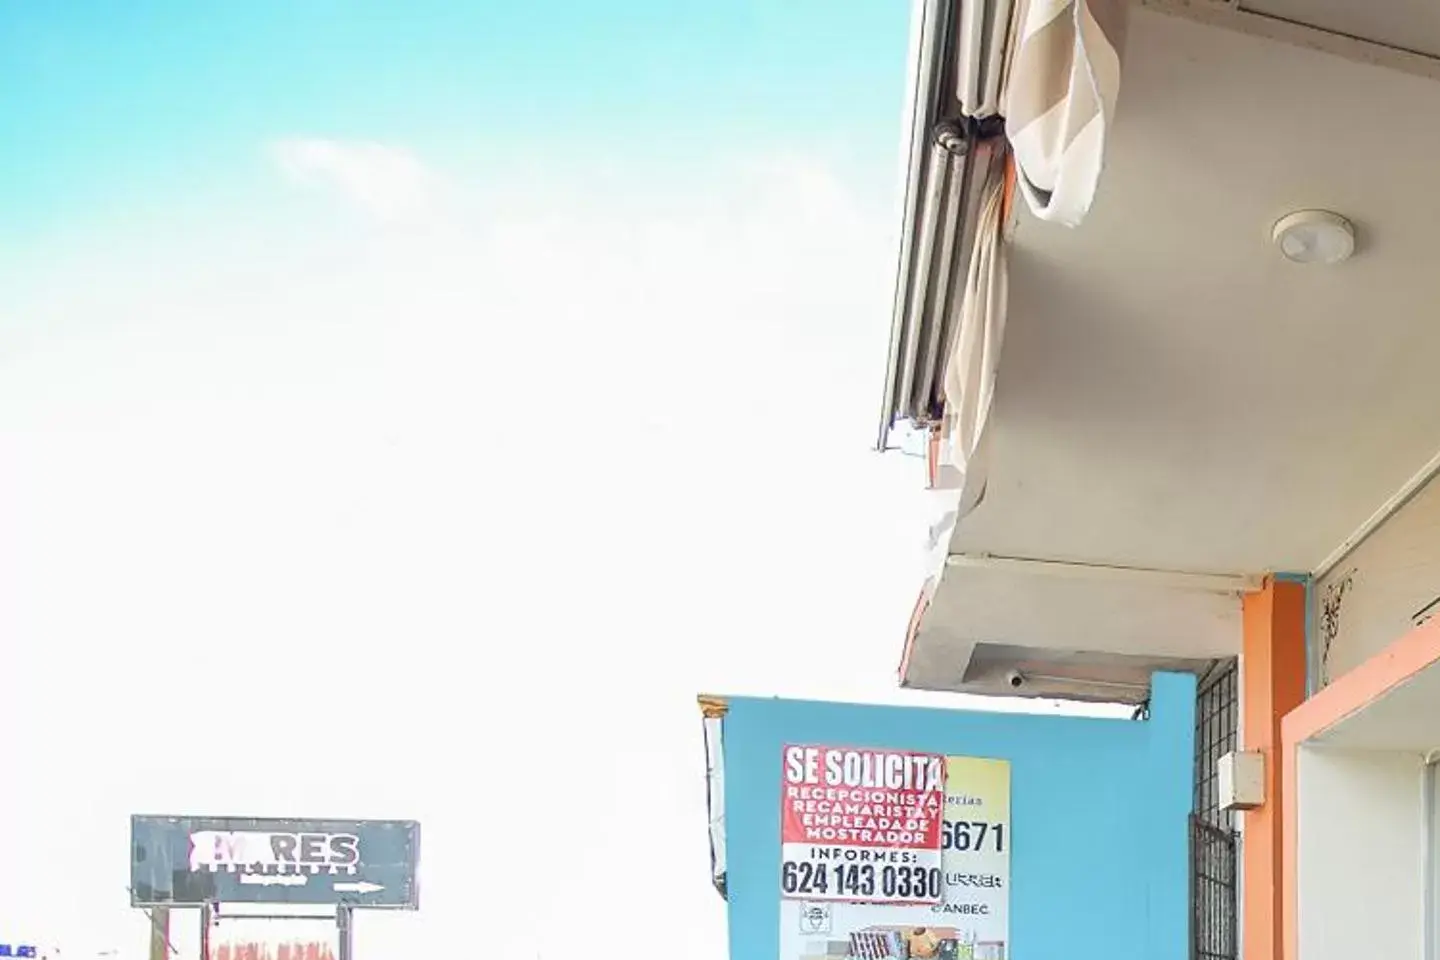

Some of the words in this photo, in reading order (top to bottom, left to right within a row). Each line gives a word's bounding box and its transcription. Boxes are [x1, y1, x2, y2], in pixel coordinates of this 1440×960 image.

[786, 747, 818, 784] SE
[825, 750, 943, 791] SOLICITA
[788, 786, 938, 807] RECEPCIONISTA
[793, 800, 925, 819] RECAMARISTA
[928, 807, 940, 820] Y
[802, 813, 903, 831] EMPLEADA
[905, 819, 930, 832] DE
[806, 828, 925, 843] MOSTRADOR
[811, 847, 918, 863] INFORMES:
[782, 861, 828, 894] 624
[834, 864, 875, 896] 143
[882, 865, 940, 898] 0330
